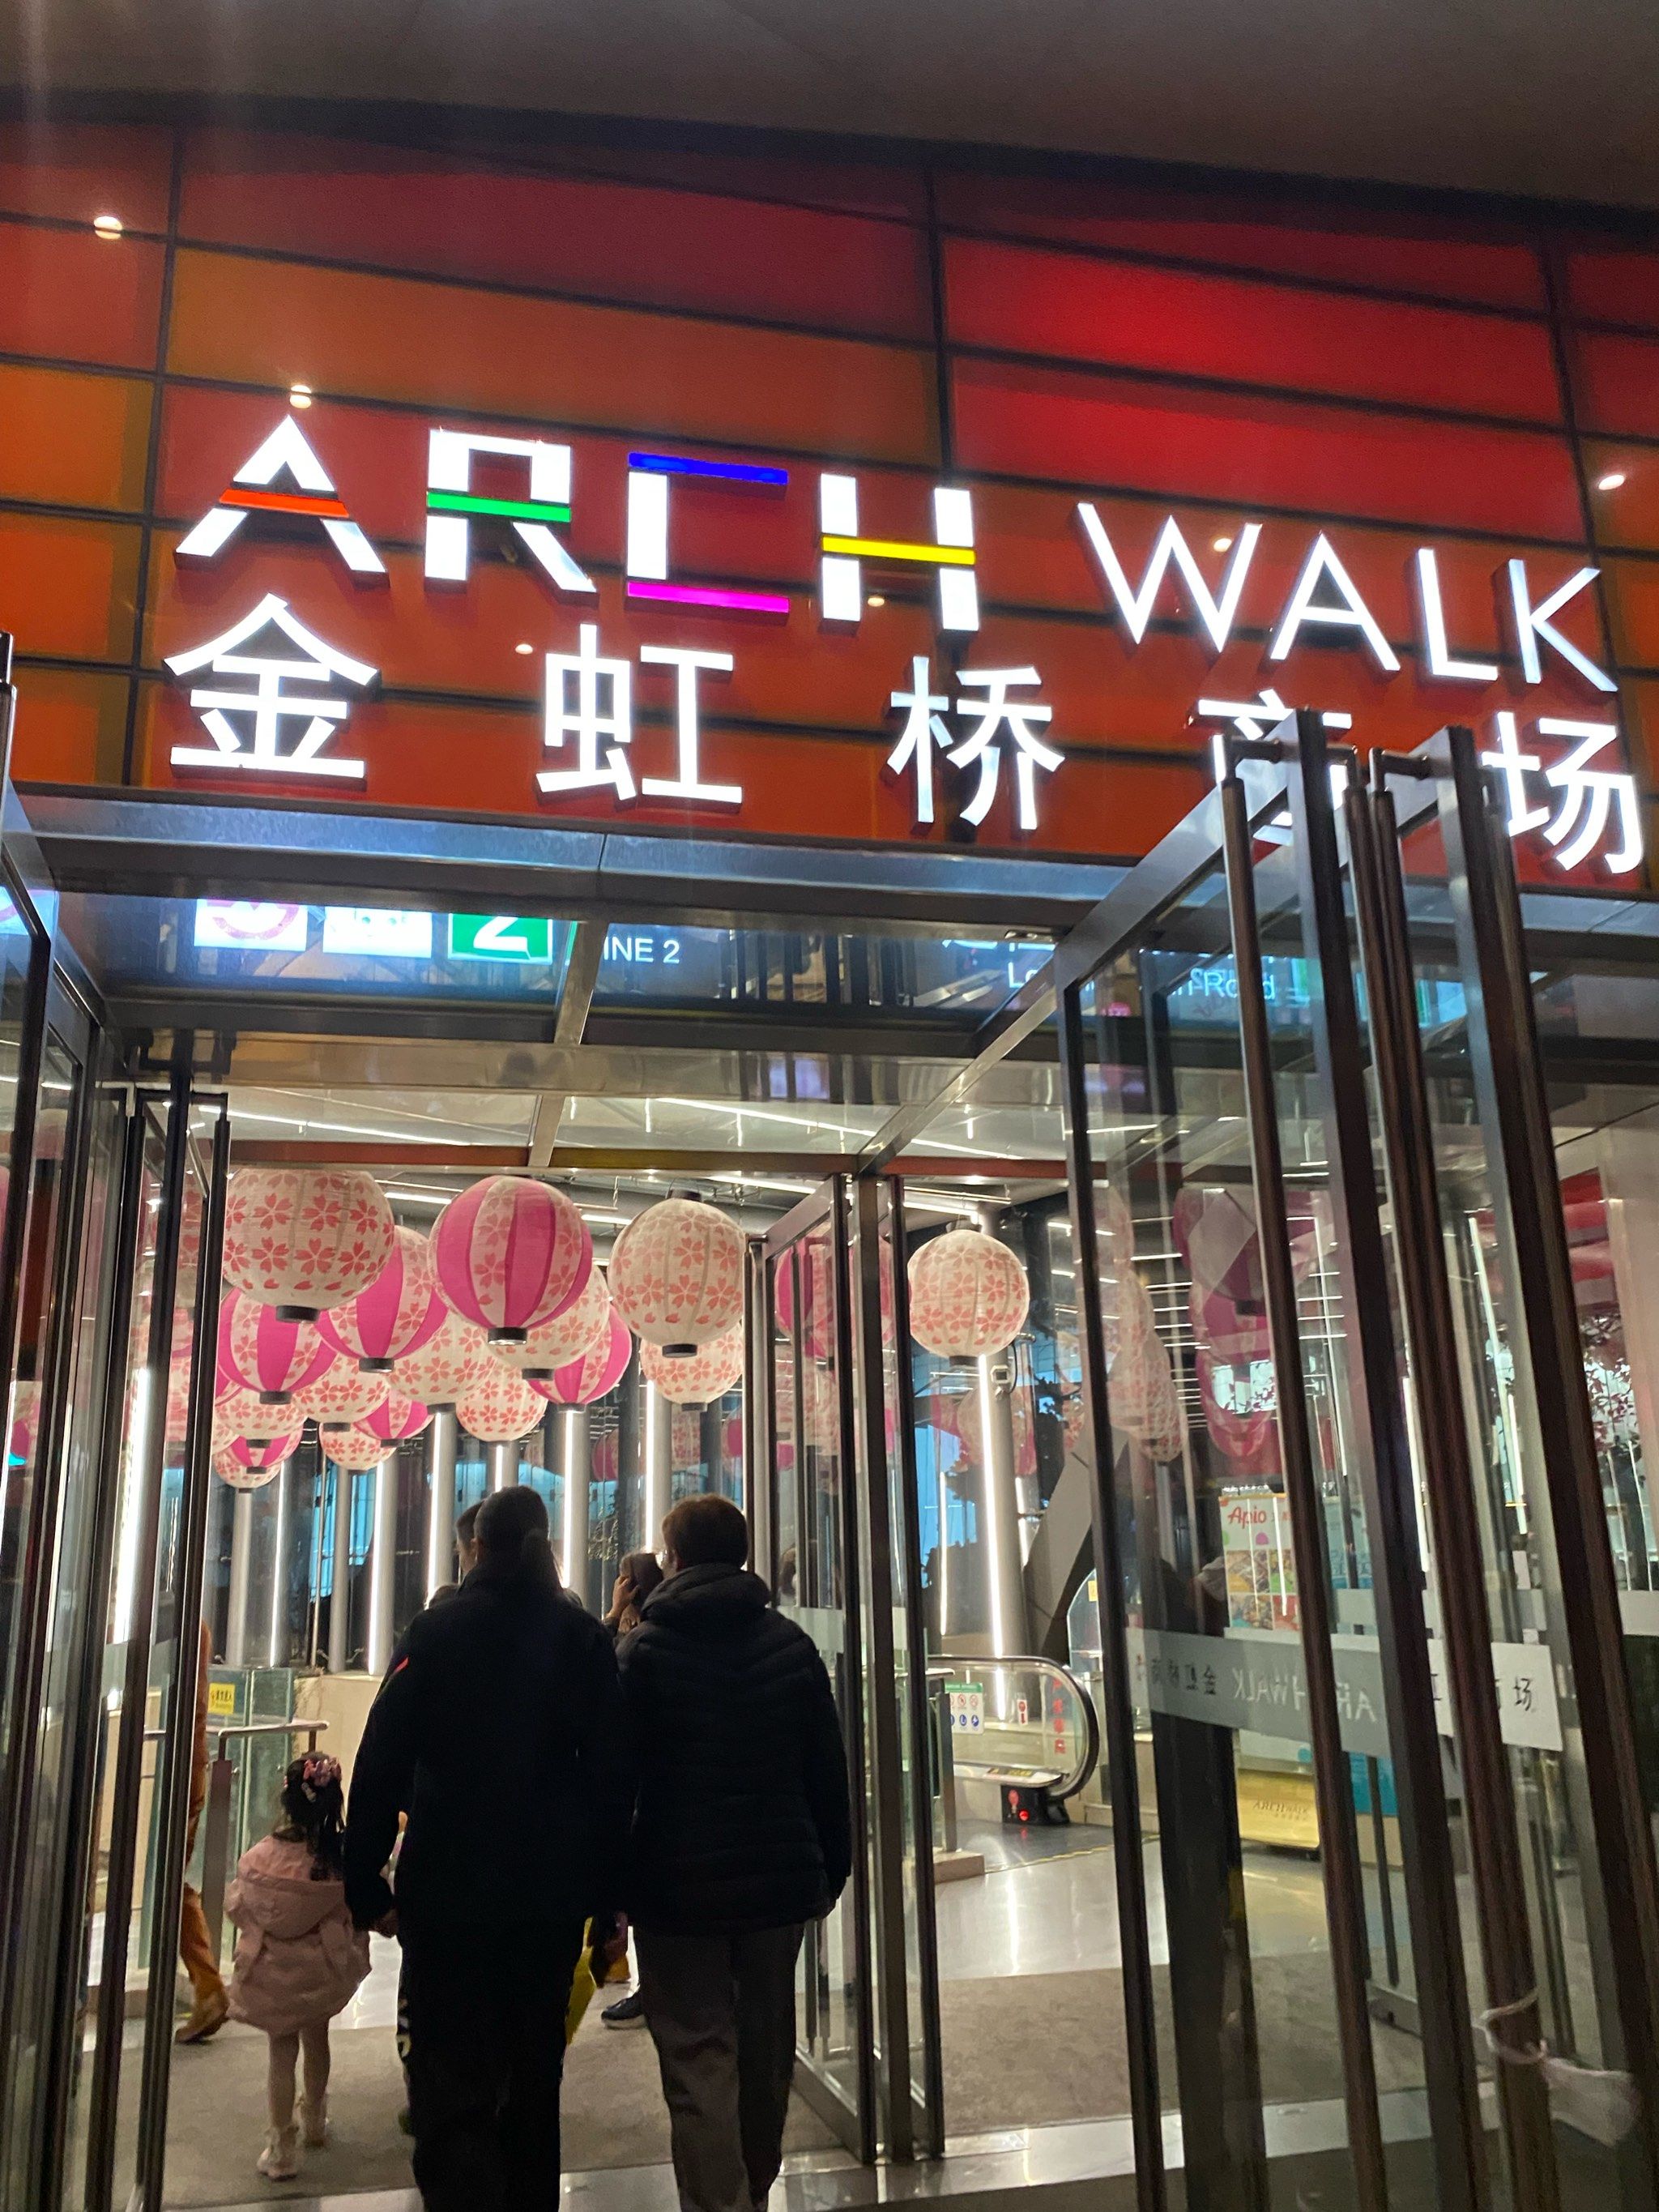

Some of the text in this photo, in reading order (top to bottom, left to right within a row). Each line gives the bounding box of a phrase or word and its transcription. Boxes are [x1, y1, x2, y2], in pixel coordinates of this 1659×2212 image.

[175, 415, 1618, 693] ARCH WALK
[603, 936, 680, 964] INE 2
[1204, 972, 1276, 1000] Rod
